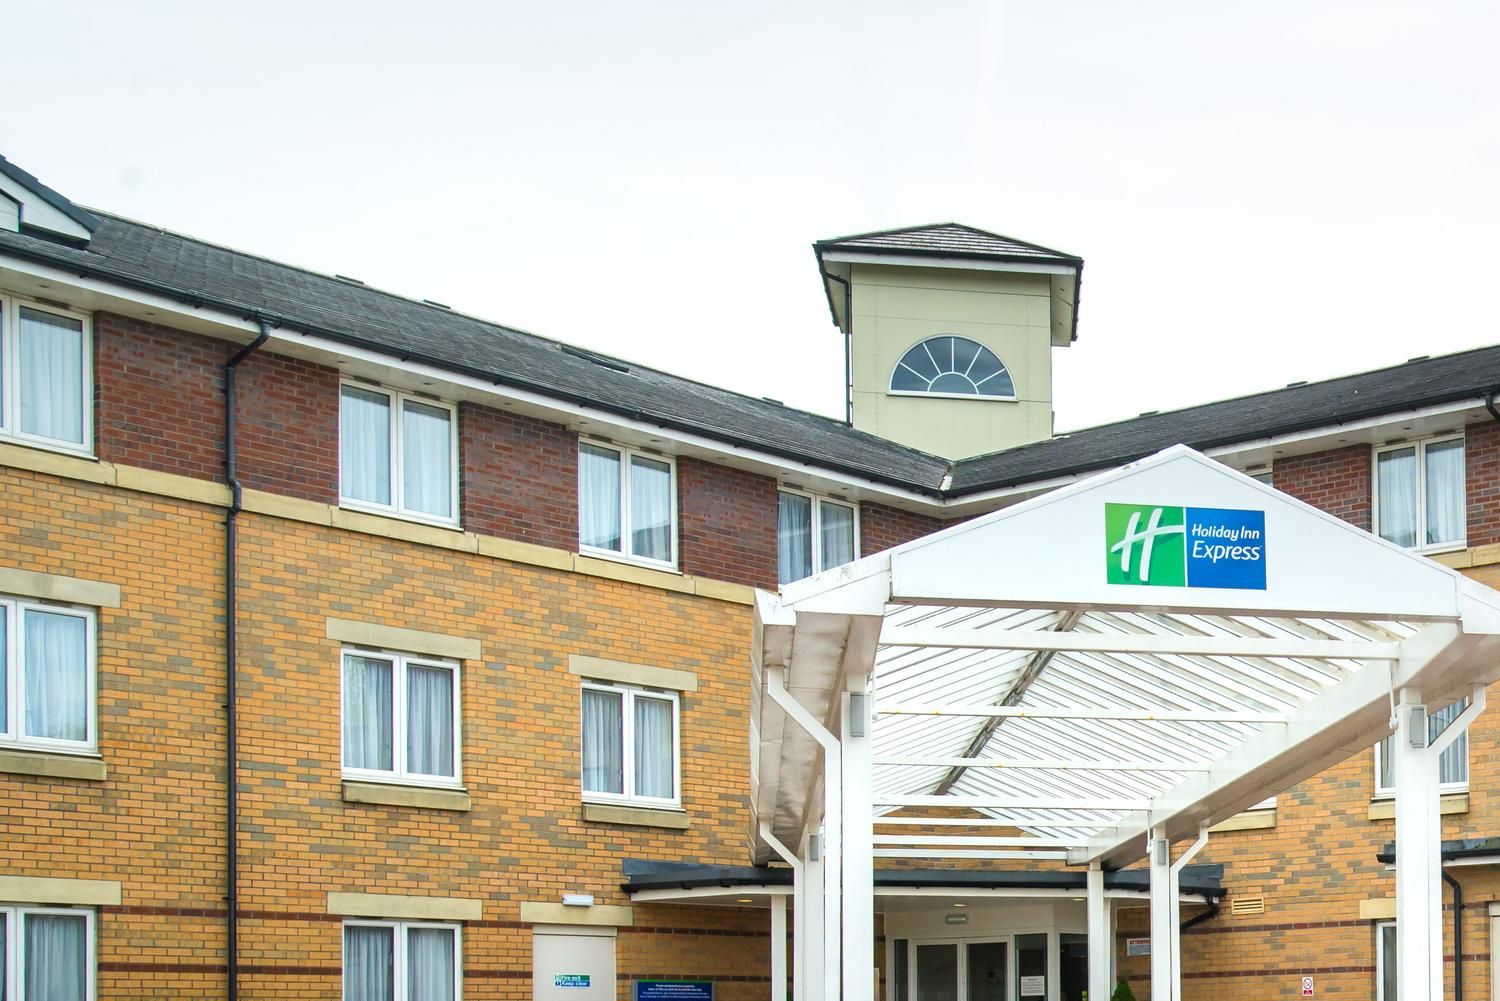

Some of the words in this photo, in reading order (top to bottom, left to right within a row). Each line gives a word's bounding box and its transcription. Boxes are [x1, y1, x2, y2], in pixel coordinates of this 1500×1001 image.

[1191, 523, 1239, 542] Holiday
[1240, 525, 1260, 539] Inn
[1192, 540, 1261, 563] Express
